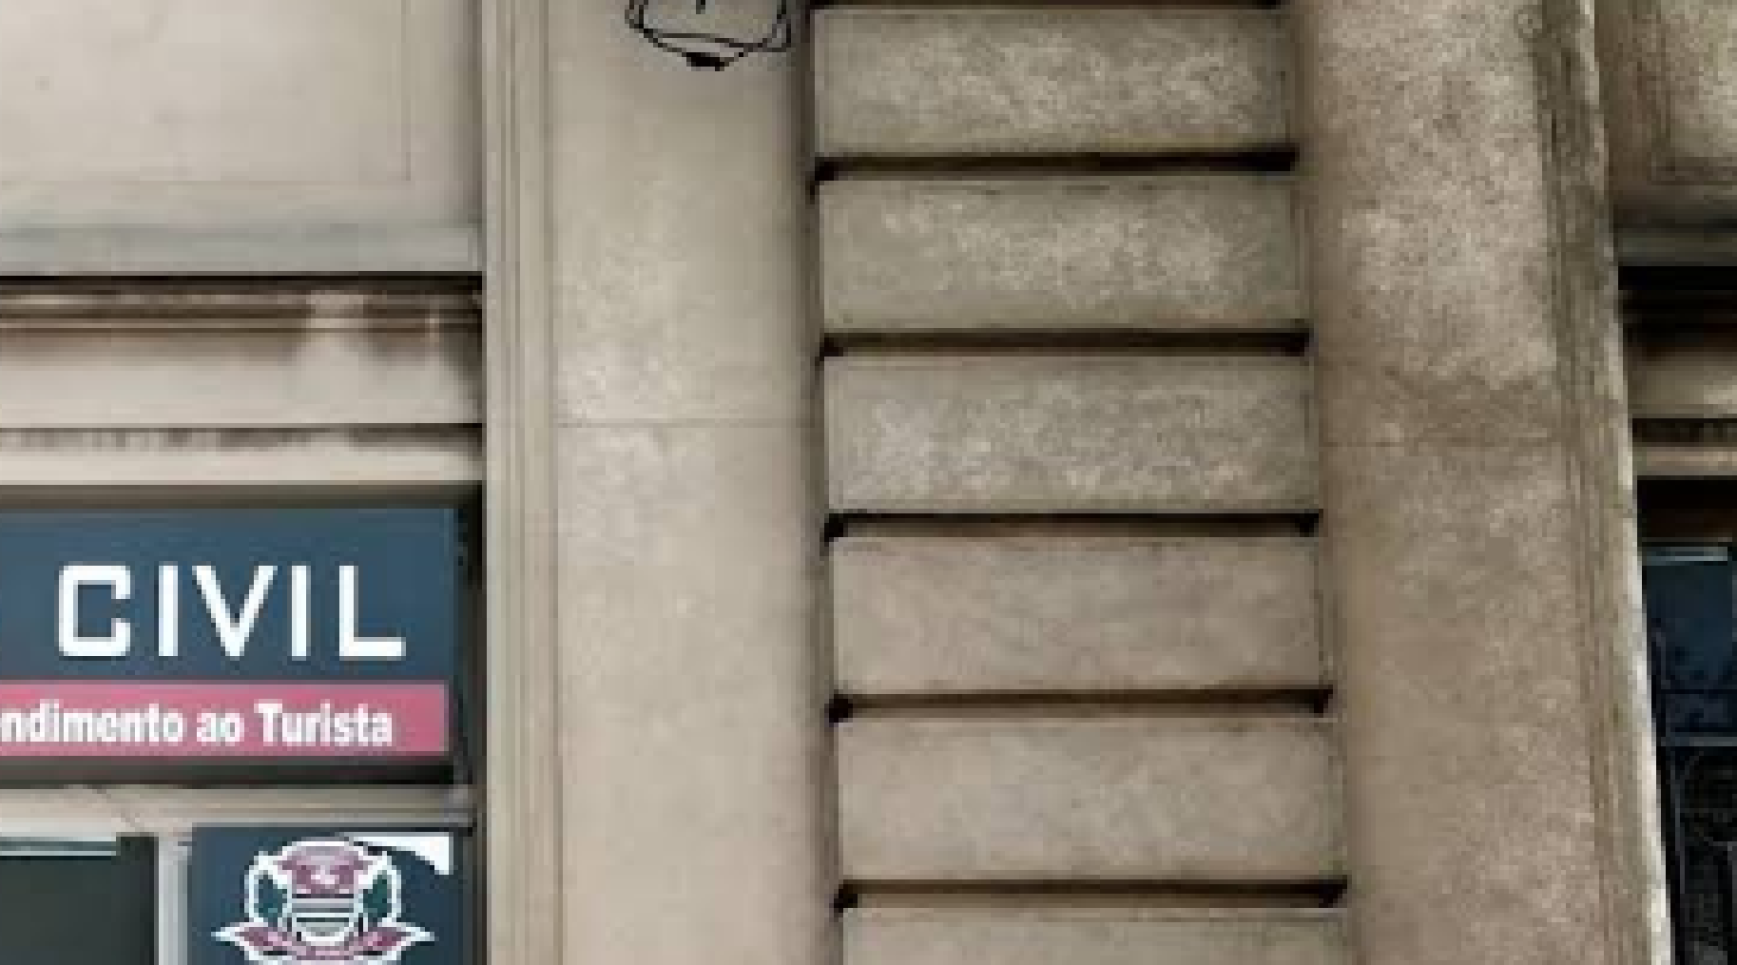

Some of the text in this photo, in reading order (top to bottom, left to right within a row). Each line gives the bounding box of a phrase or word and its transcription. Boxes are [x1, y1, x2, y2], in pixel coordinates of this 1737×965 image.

[57, 563, 407, 660] CIVIL
[196, 707, 244, 746] ao
[252, 698, 393, 747] Turista
